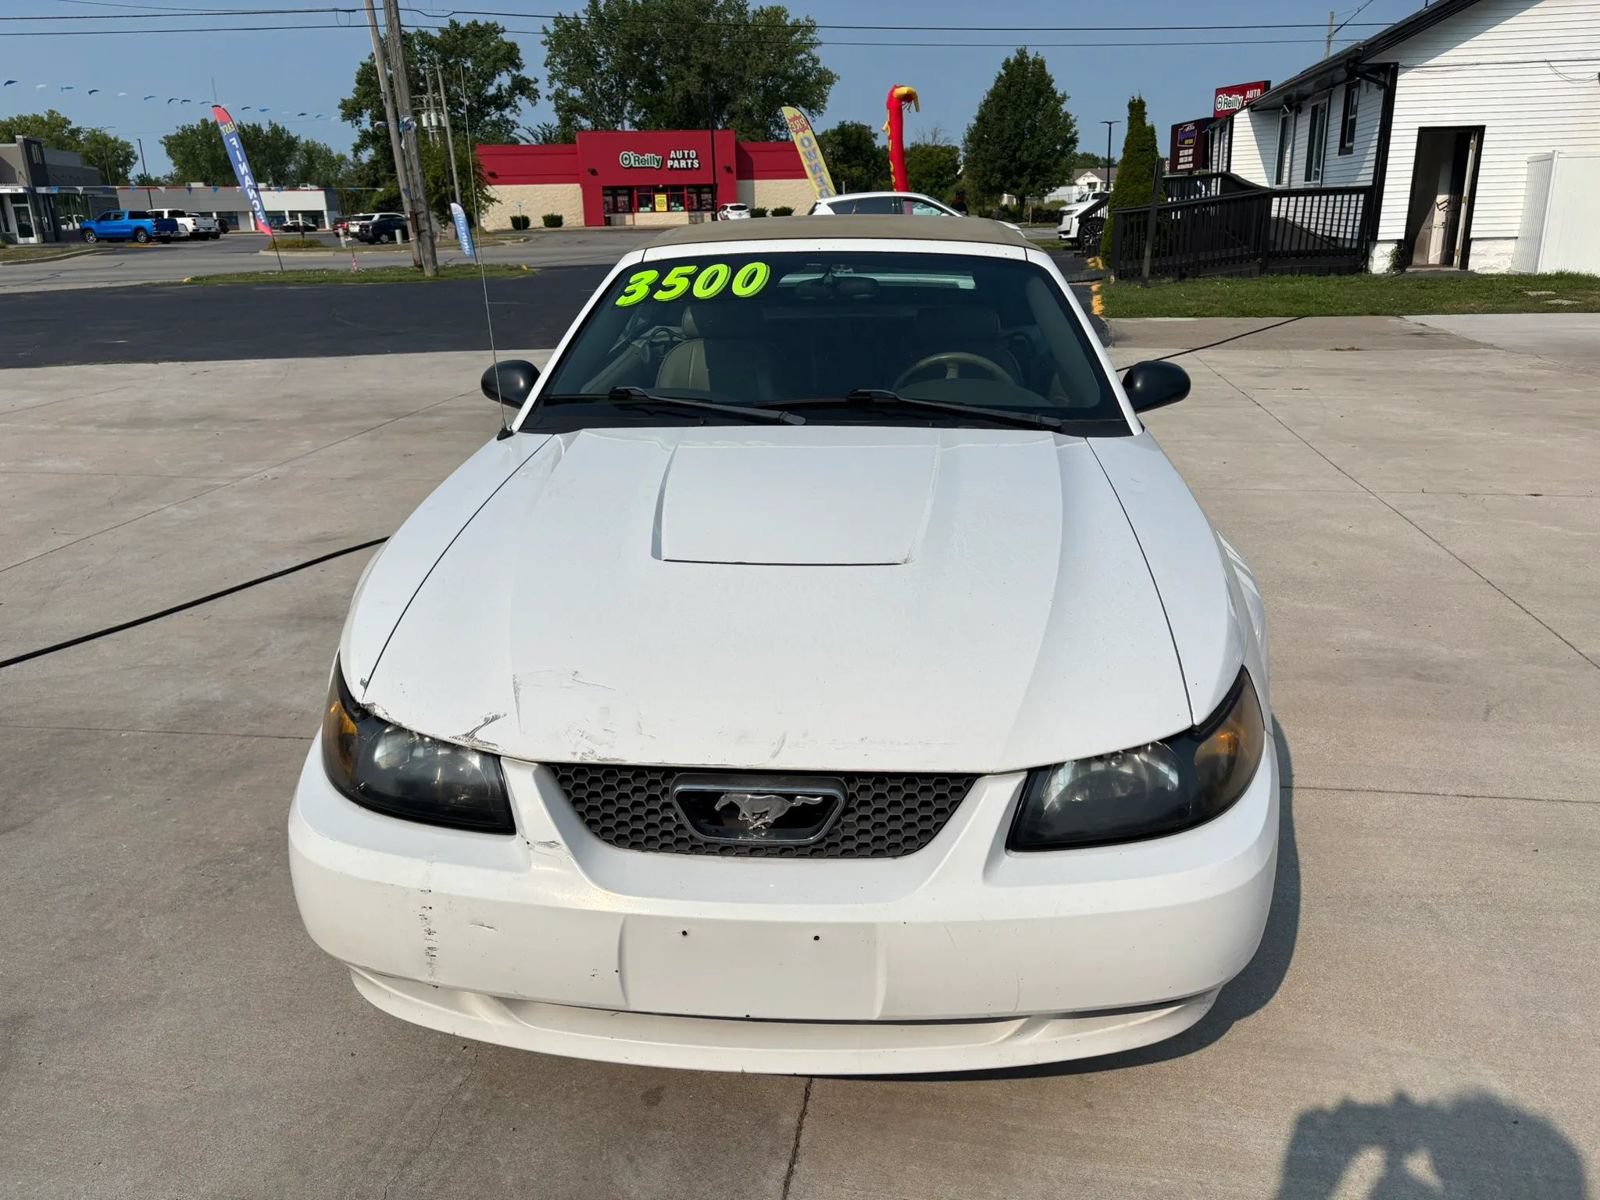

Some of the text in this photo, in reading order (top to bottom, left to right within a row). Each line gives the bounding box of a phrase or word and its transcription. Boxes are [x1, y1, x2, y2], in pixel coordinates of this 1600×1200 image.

[1216, 93, 1243, 111] O'Reilly
[619, 151, 662, 168] O'Reilly
[670, 150, 696, 159] AUTO
[667, 160, 699, 169] PARTS
[615, 262, 770, 307] 3500
